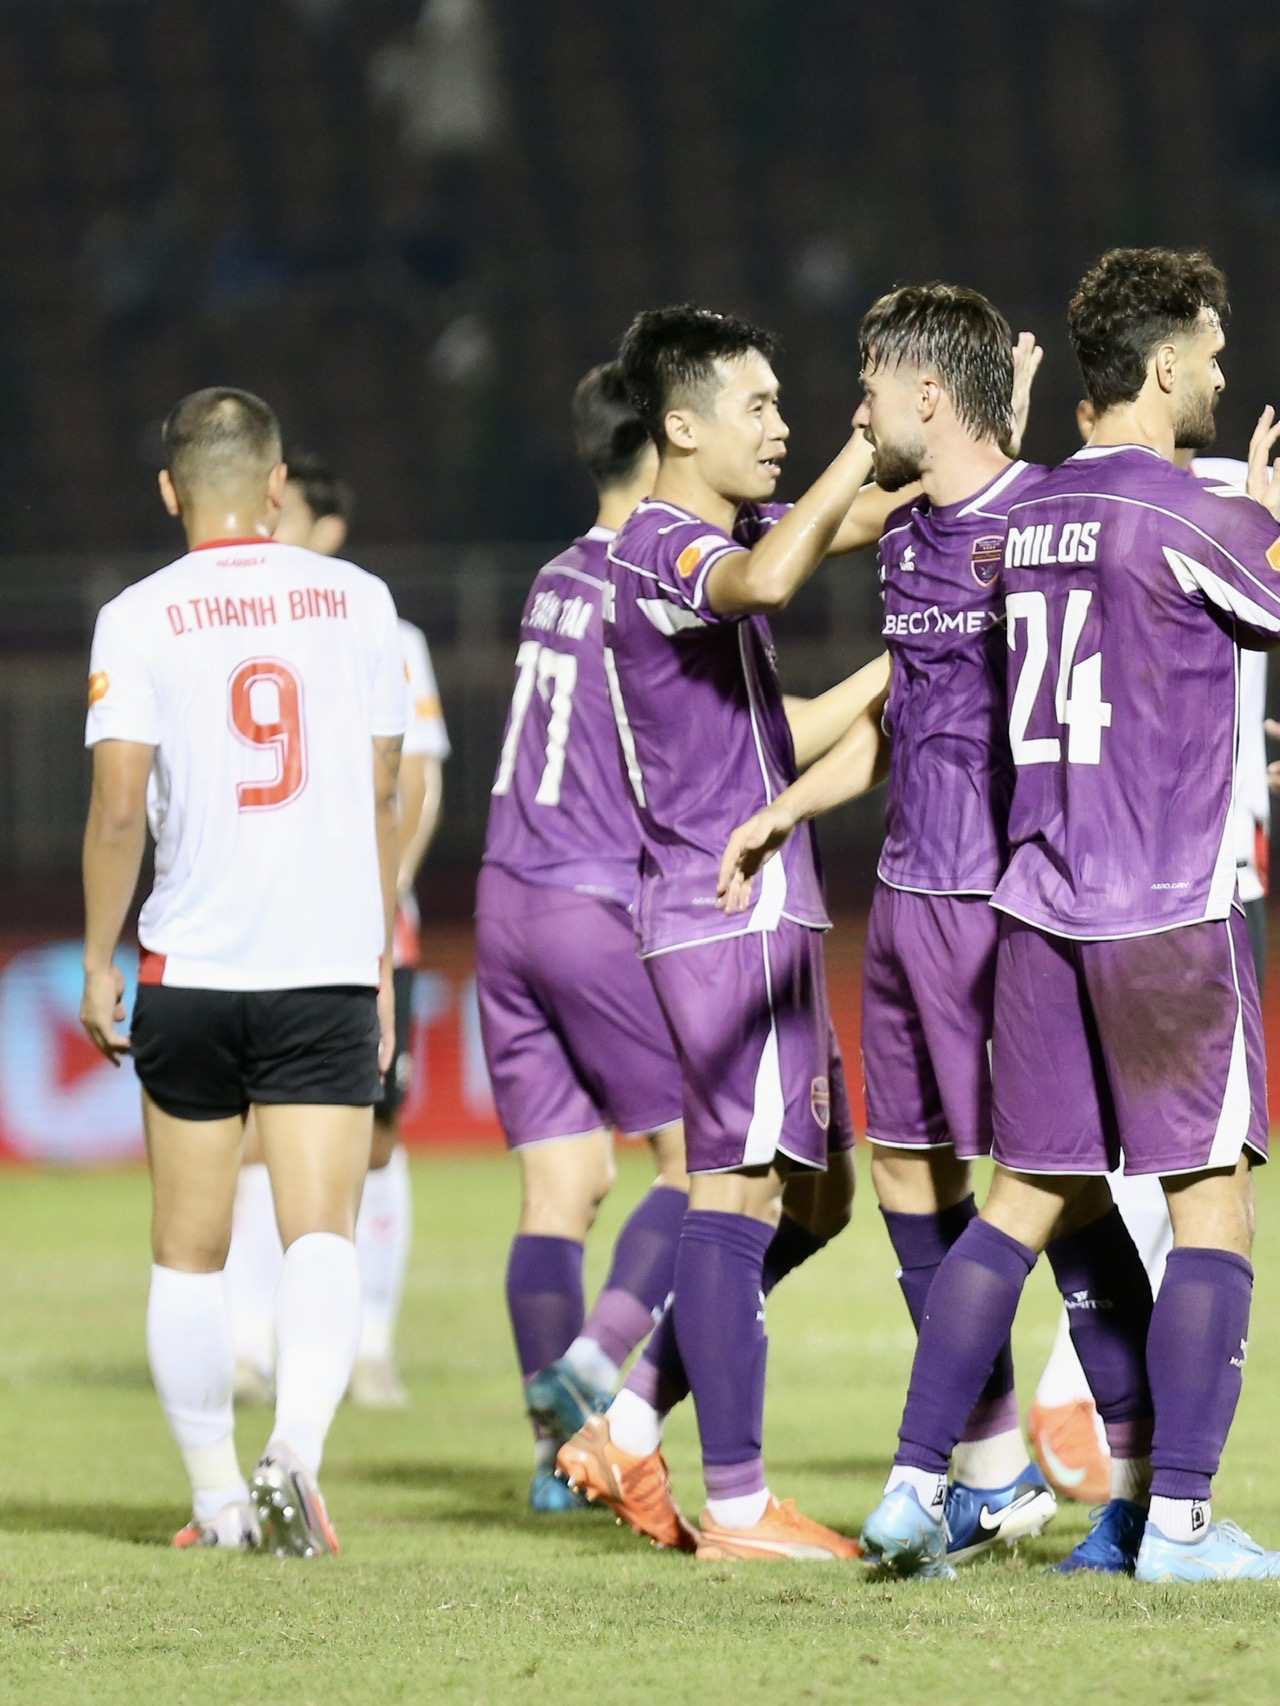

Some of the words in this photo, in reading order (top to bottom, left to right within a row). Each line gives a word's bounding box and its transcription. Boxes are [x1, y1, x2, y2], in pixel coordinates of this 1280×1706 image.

[288, 587, 348, 621] BINH
[1004, 521, 1102, 569] MILOS
[227, 655, 310, 815] 9
[491, 640, 578, 807] 77
[1005, 589, 1112, 766] 24
